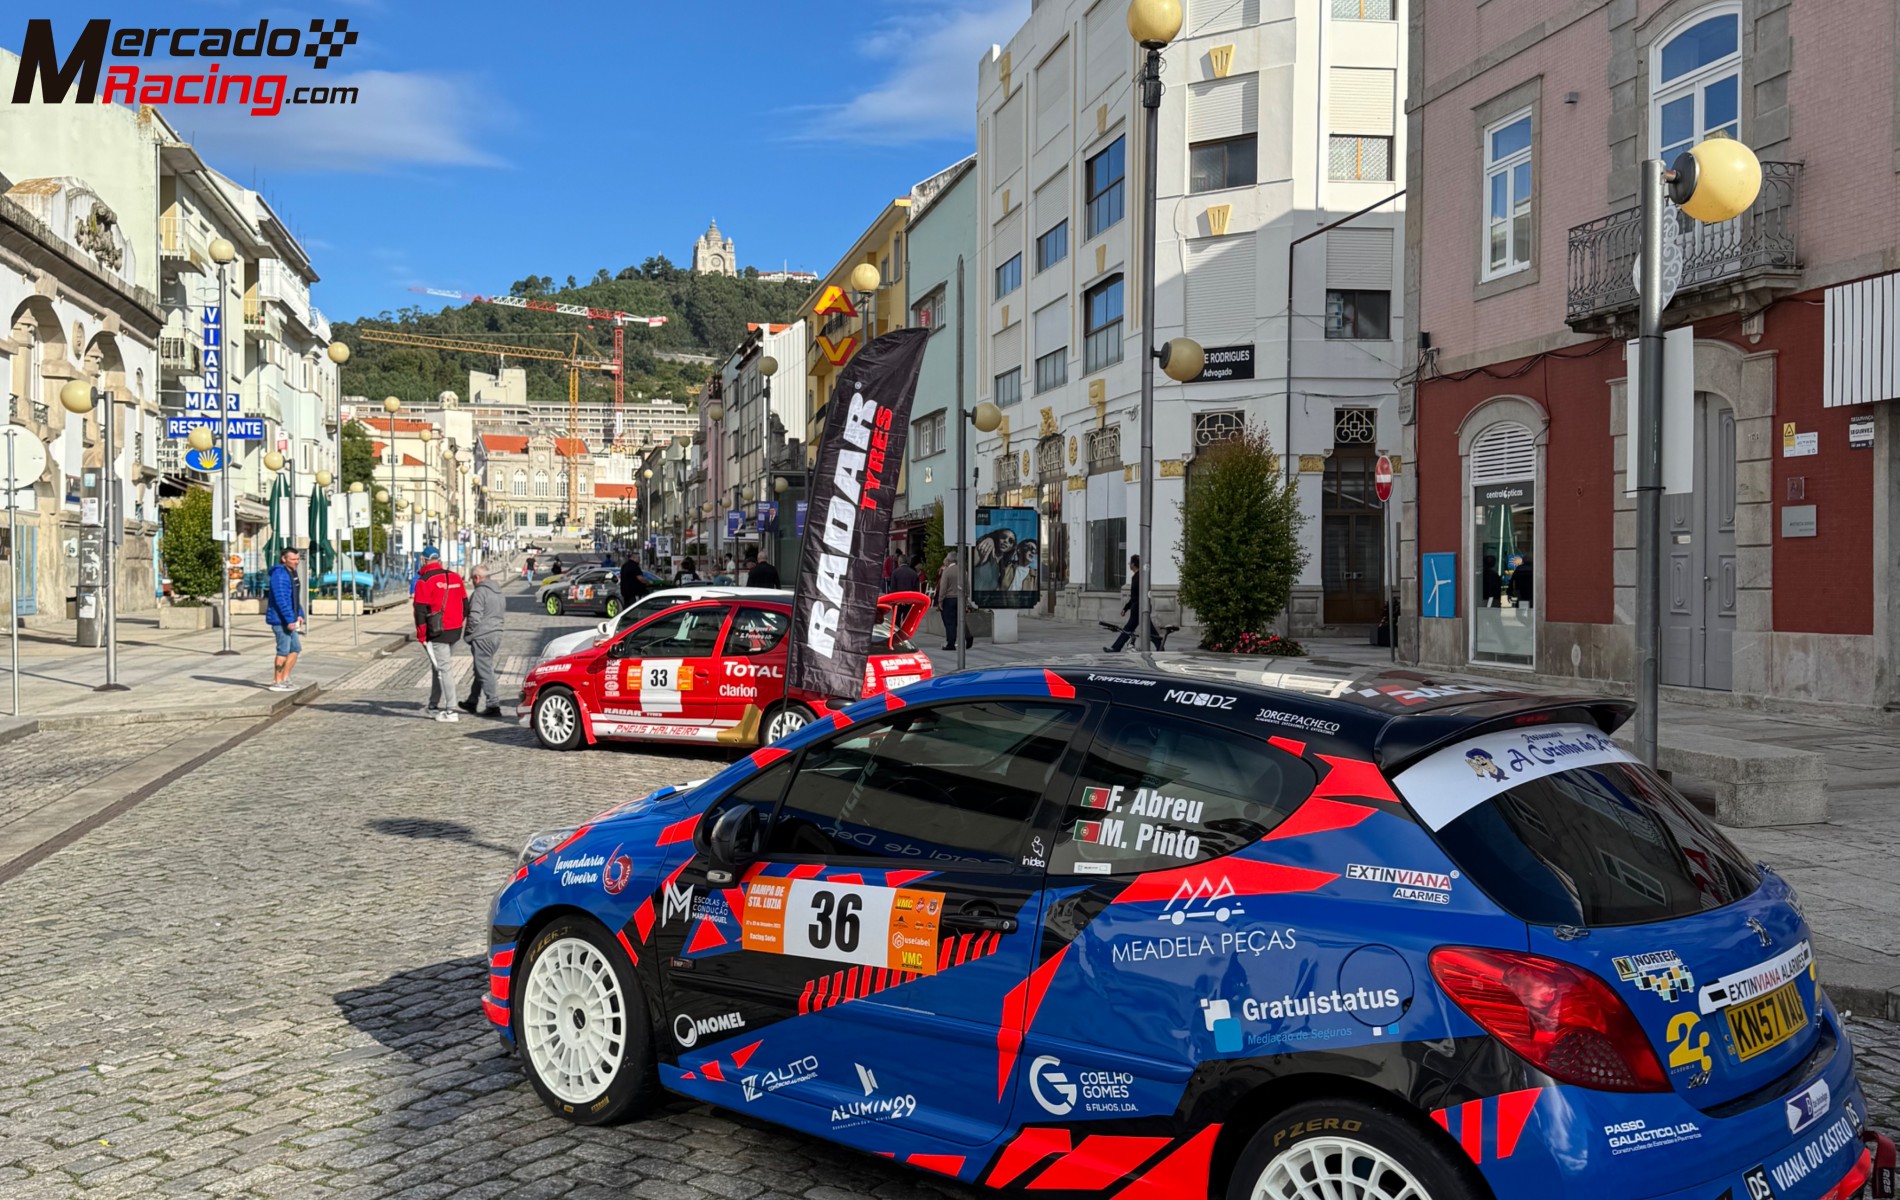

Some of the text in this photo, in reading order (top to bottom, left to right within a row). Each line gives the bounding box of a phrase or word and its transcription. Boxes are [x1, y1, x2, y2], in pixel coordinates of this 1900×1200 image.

[1210, 350, 1250, 363] RODRIGUES
[1203, 367, 1232, 378] Advogado
[170, 420, 262, 436] RESTAUANTE
[860, 405, 893, 510] TYRES
[807, 391, 878, 659] RADAR
[535, 664, 572, 674] MICHELIN
[723, 661, 784, 678] TOTAL
[650, 669, 668, 687] 33
[719, 684, 757, 697] Clarion
[604, 708, 641, 717] RADAR
[614, 724, 700, 736] PNEUS MALHEIRO
[1107, 785, 1203, 823] F. Abreu
[1099, 818, 1200, 860] M. Pinto
[562, 870, 598, 886] Oliveira
[1347, 866, 1452, 890] EXTINVIANA
[751, 884, 785, 897] RAMPA DE
[1394, 888, 1450, 904] ALARMES
[694, 896, 720, 906] ESCOLAS
[748, 896, 782, 910] STA. LUZIA
[692, 912, 727, 924] MARIA MIGUEL
[693, 904, 728, 916] CONDUÇÃO
[808, 890, 863, 953] 36
[1112, 928, 1296, 963] MEADELA PEÇAS
[902, 951, 923, 966] VMC
[1729, 952, 1806, 1001] EXTINVIANA ALARMES
[1242, 986, 1400, 1021] Gratuistatus
[697, 1012, 746, 1035] MOMEL
[1730, 997, 1781, 1053] KN57
[1248, 1032, 1294, 1046] Mediação
[1310, 1027, 1352, 1042] Seguros
[762, 1055, 818, 1087] AUTO
[1080, 1072, 1134, 1085] COELHO
[1688, 1070, 1712, 1089] 207
[1082, 1085, 1129, 1099] GOMES
[1121, 1103, 1139, 1112] LDA.
[1604, 1119, 1646, 1136] PASSO
[1608, 1122, 1699, 1148] GALACTICO, LDA.
[1771, 1159, 1811, 1192] VIANA
[1805, 1142, 1825, 1170] DO
[1822, 1117, 1854, 1161] CASTELO
